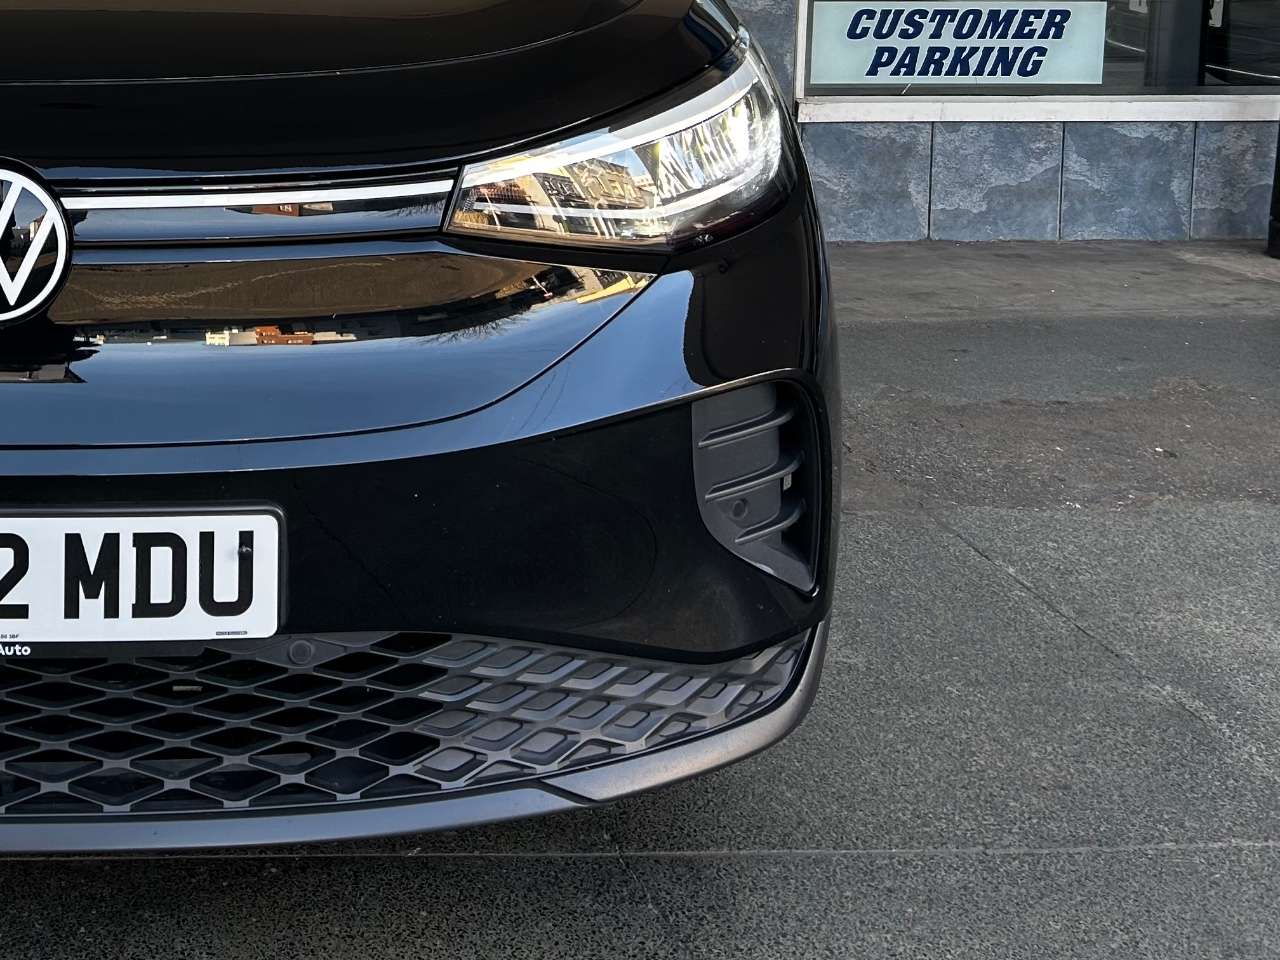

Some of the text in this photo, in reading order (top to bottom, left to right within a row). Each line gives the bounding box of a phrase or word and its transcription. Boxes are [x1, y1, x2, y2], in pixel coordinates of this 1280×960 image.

[846, 8, 1072, 41] CUSTOMER
[865, 46, 1049, 78] PARKING
[63, 529, 256, 620] MDU
